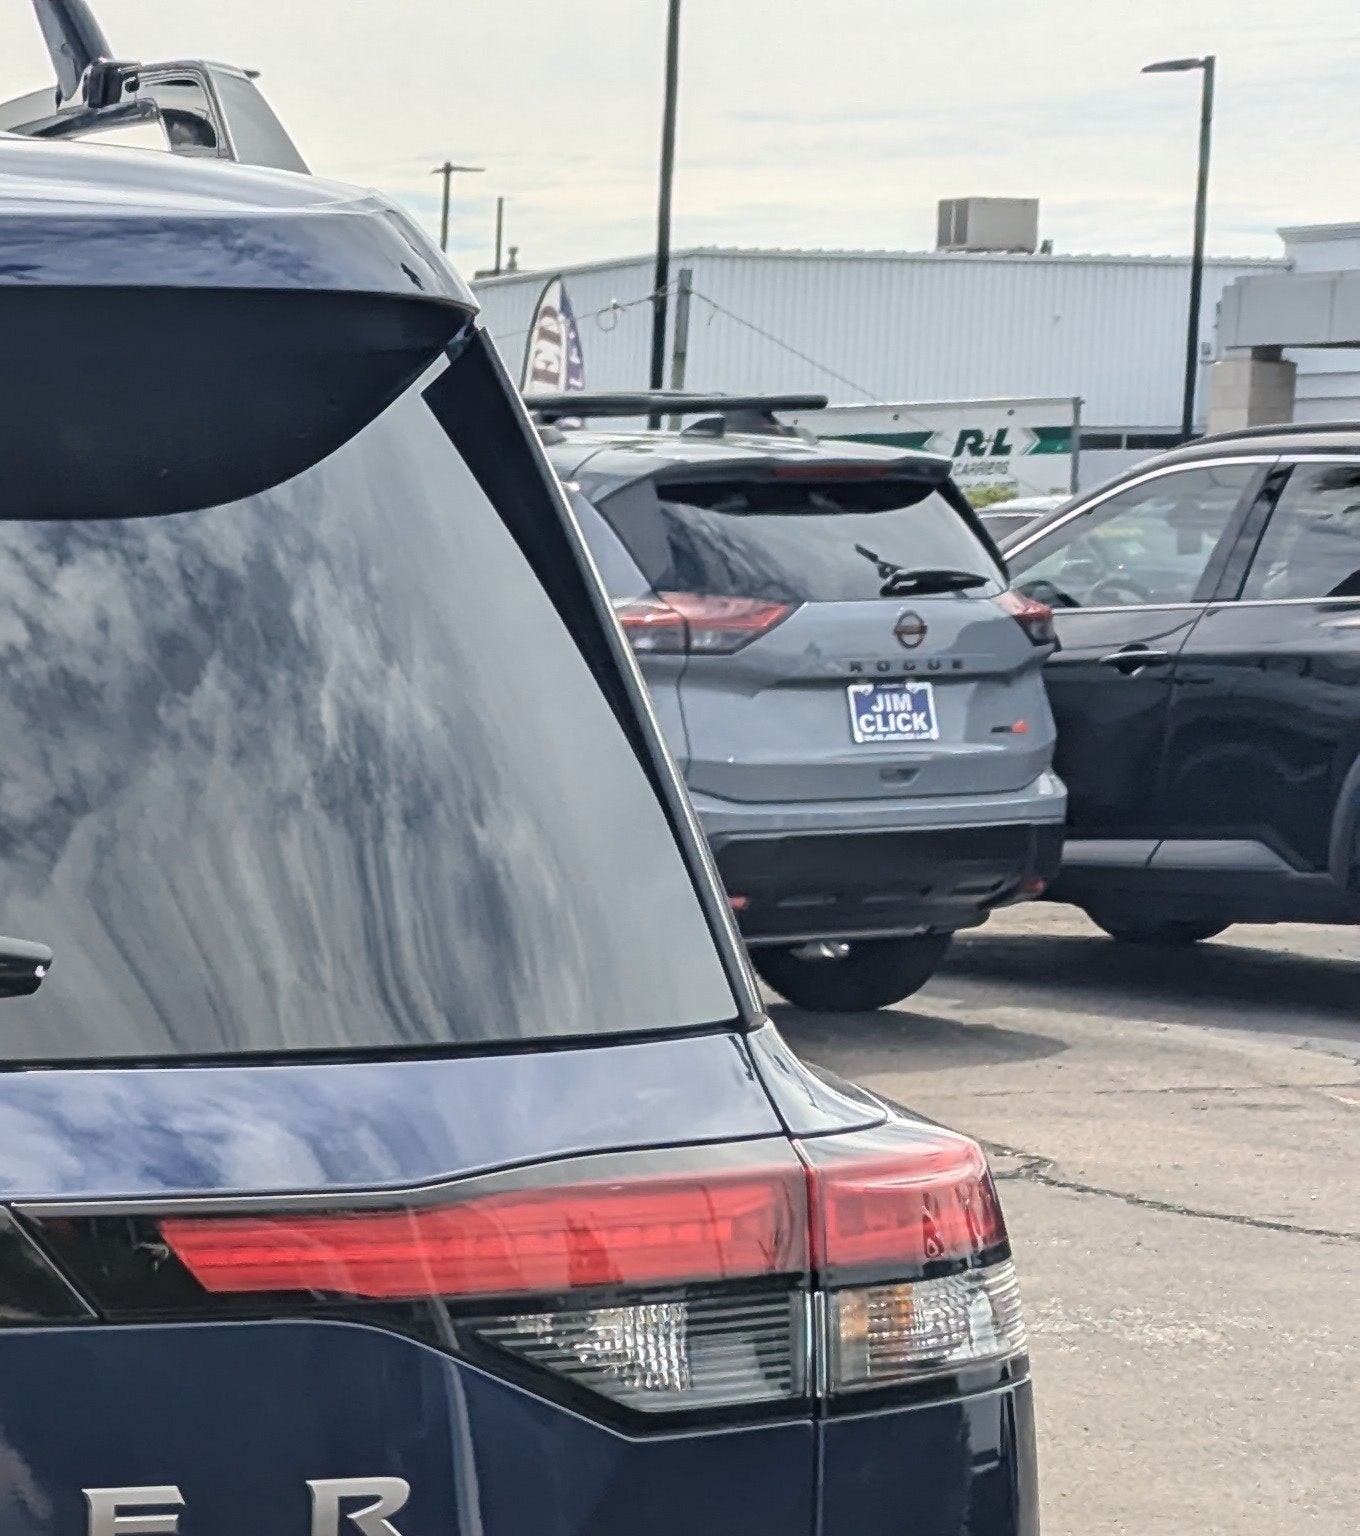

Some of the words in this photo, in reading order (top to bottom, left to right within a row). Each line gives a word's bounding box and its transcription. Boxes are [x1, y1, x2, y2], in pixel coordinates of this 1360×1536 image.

[849, 659, 964, 672] ROGUE
[871, 693, 912, 713] JIM
[859, 712, 928, 734] CLICK
